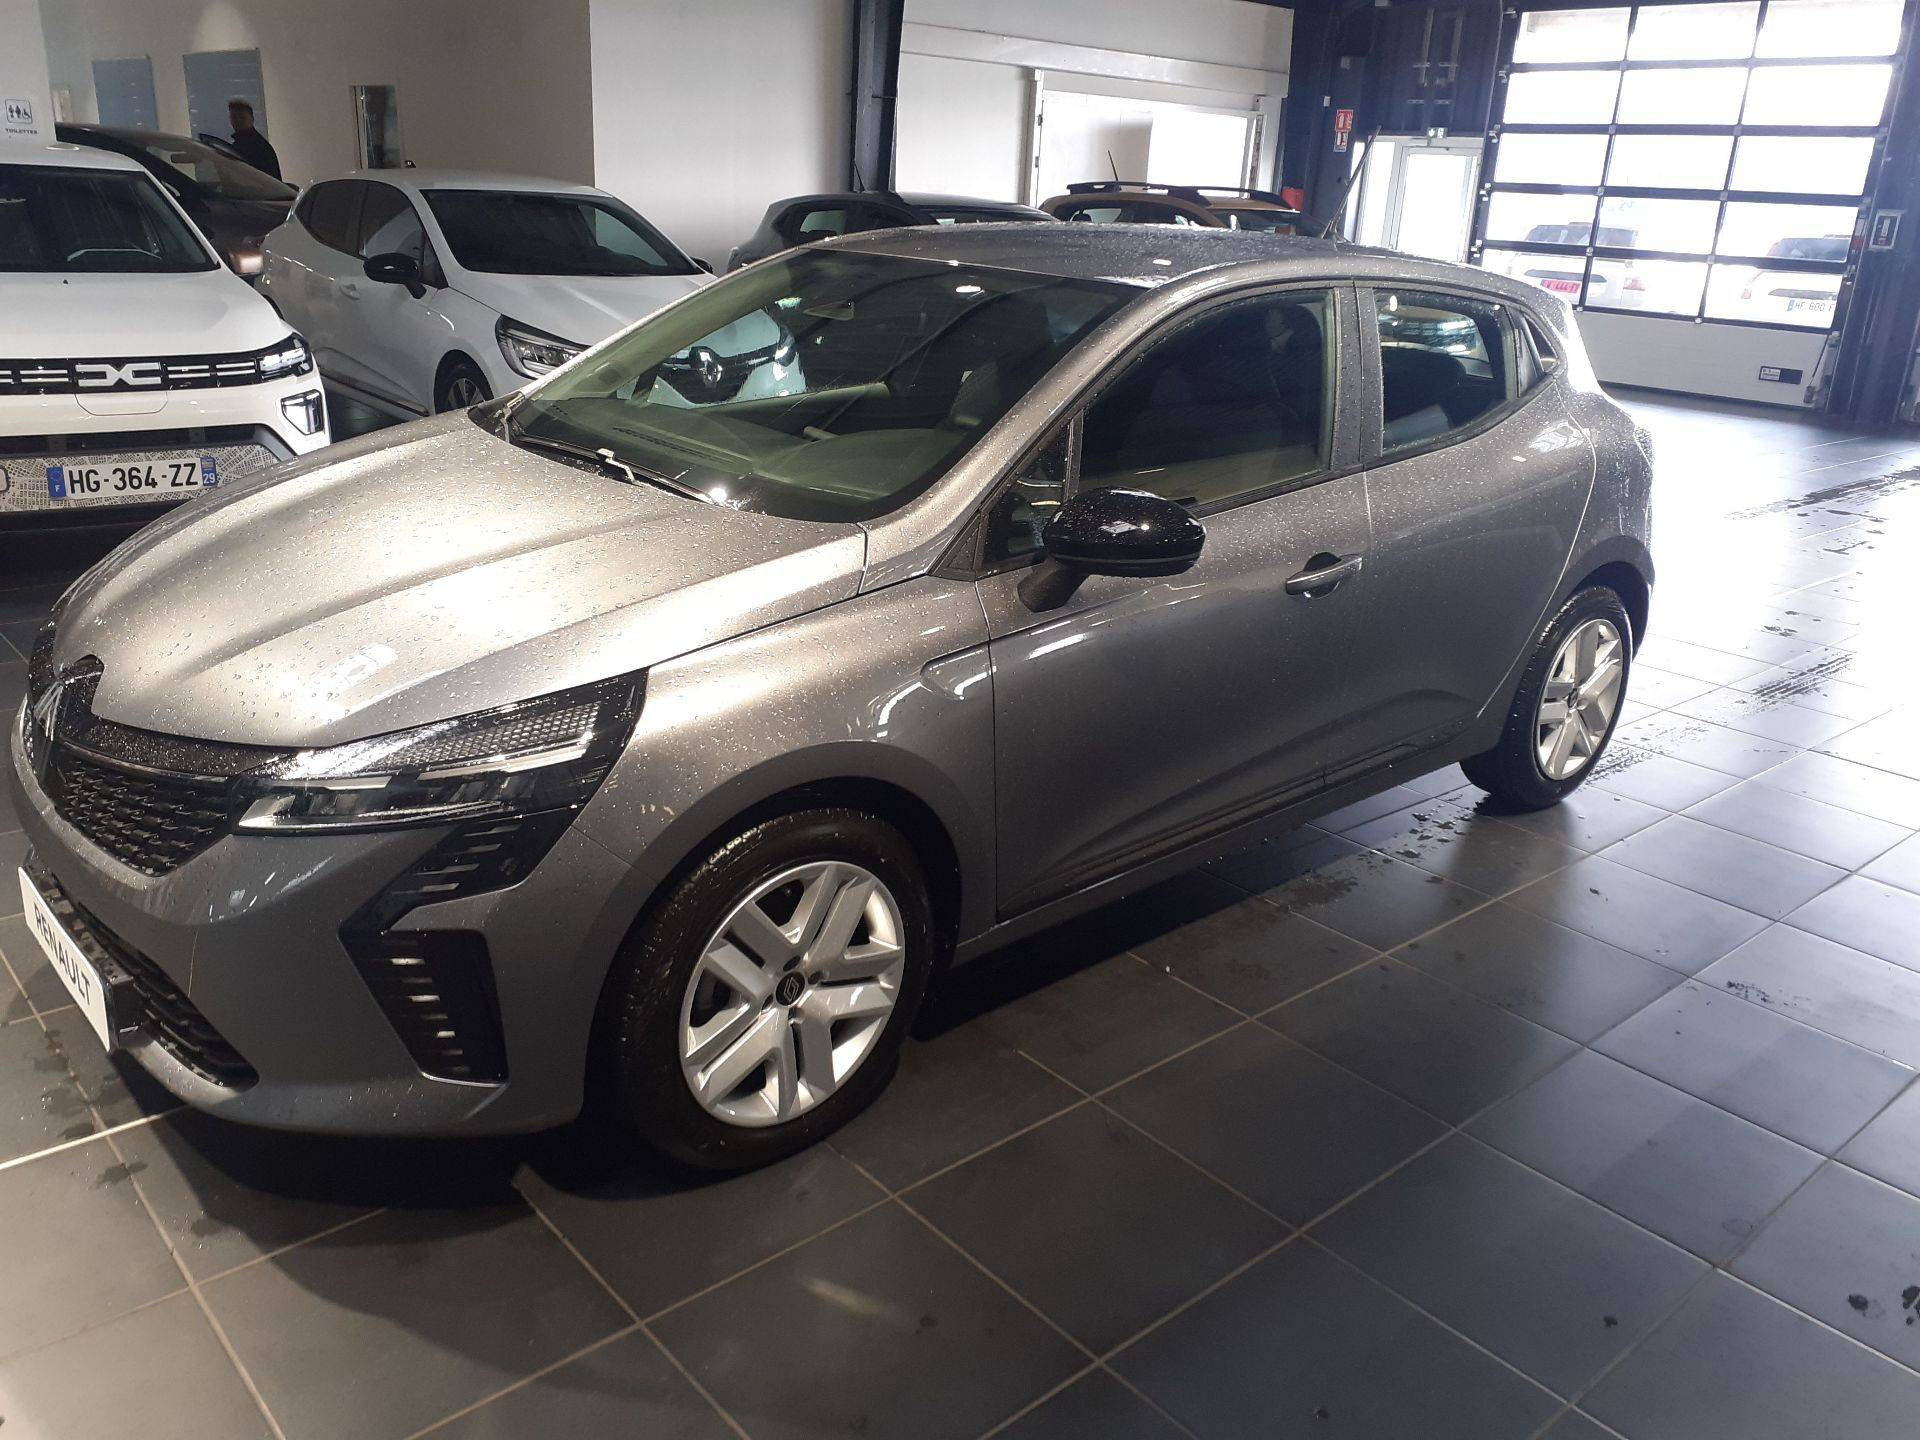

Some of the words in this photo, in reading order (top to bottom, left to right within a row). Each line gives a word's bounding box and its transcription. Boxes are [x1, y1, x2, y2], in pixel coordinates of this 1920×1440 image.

[69, 463, 198, 493] HG-364-ZZ
[203, 473, 215, 483] 29
[33, 903, 91, 1006] RENAULT
